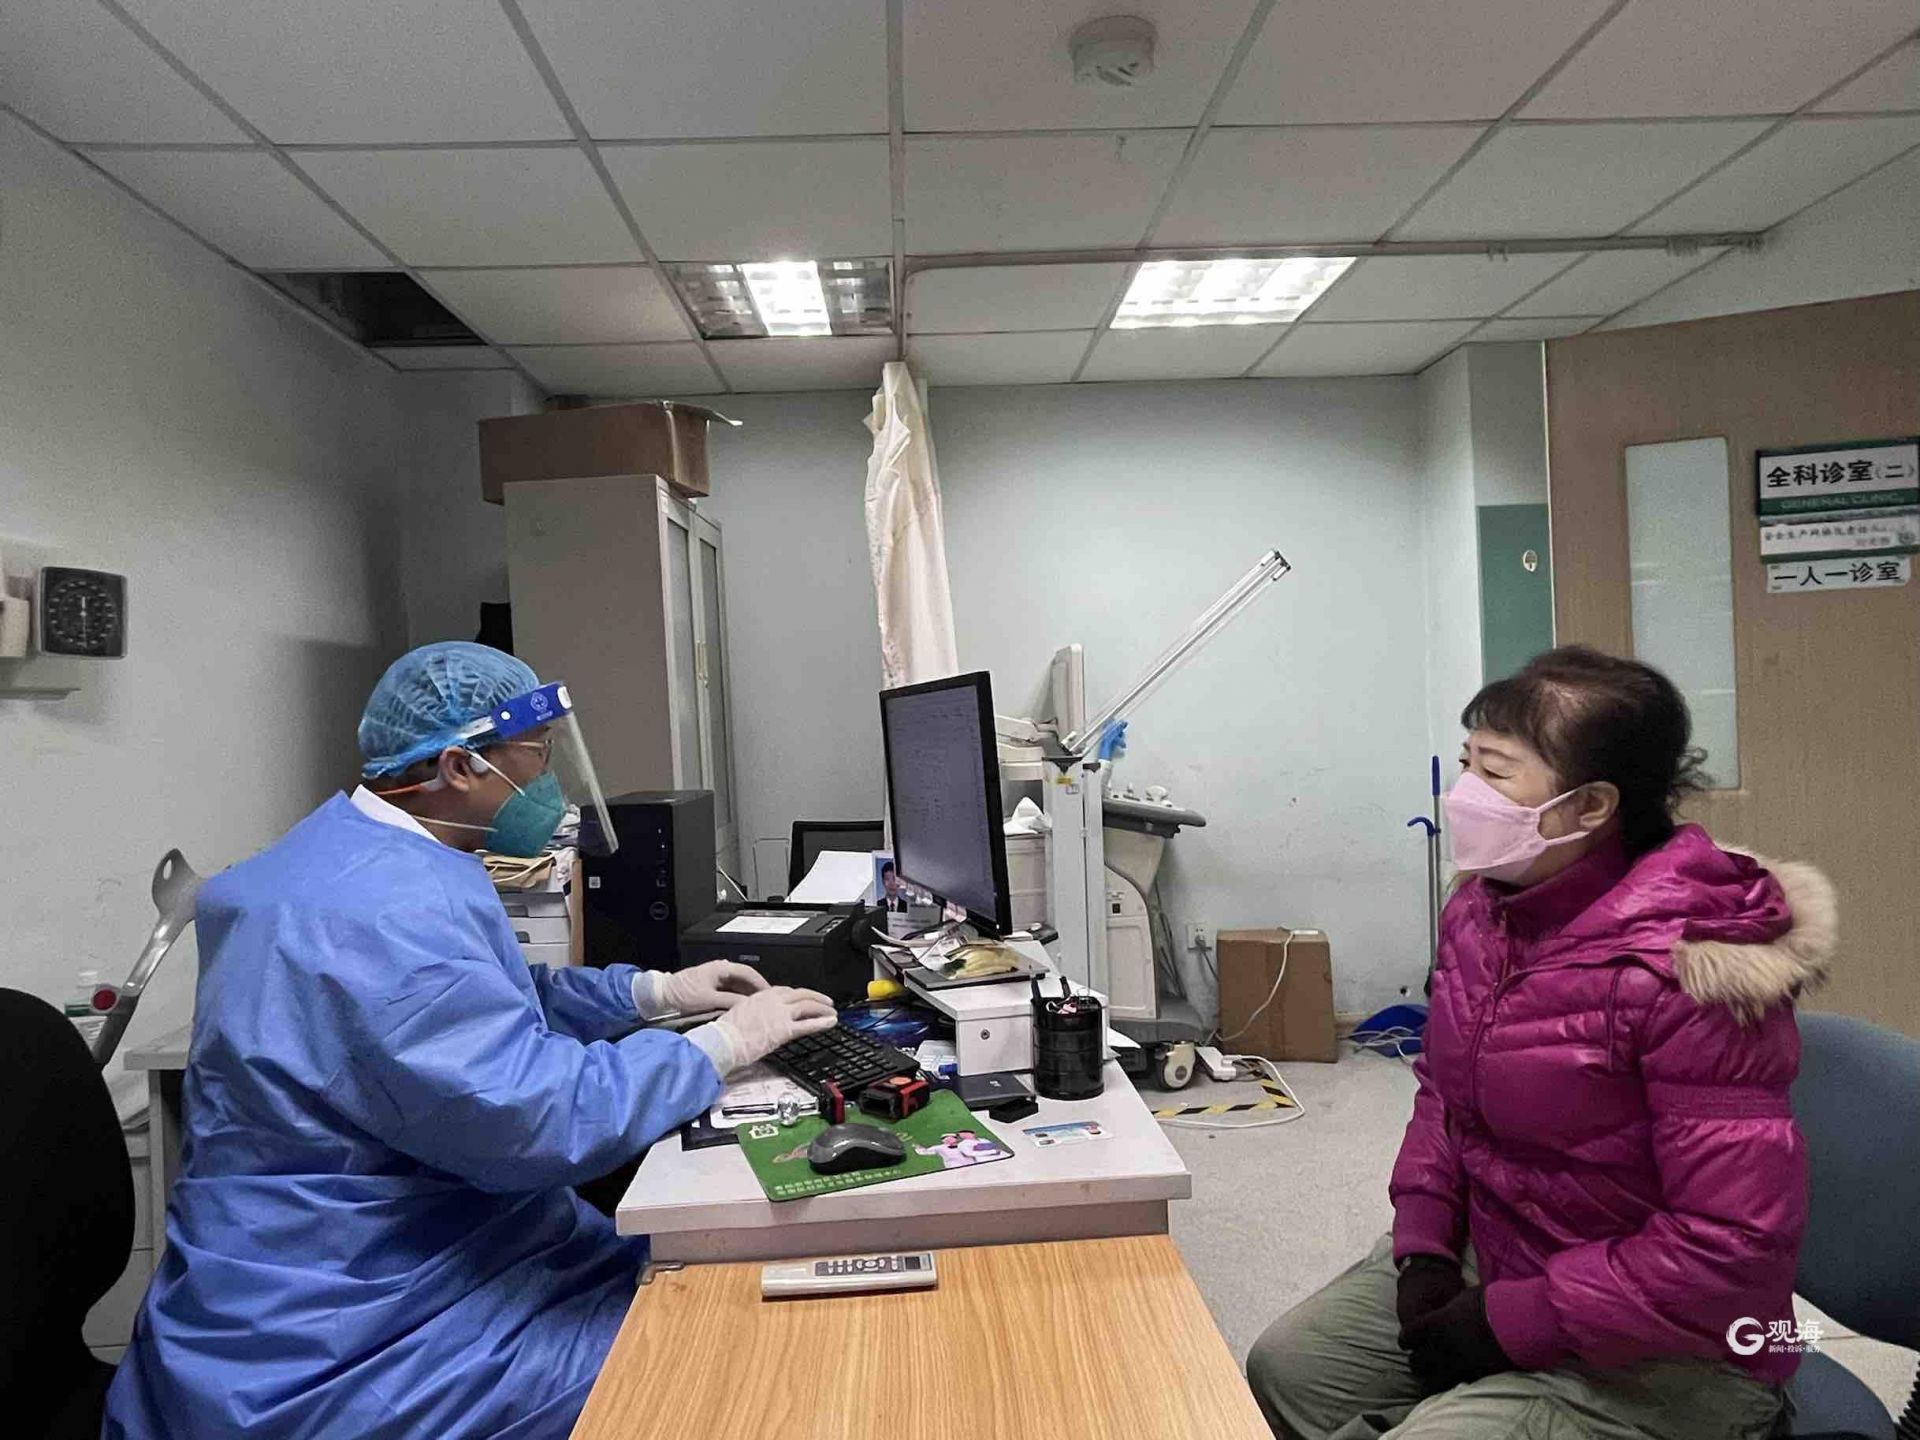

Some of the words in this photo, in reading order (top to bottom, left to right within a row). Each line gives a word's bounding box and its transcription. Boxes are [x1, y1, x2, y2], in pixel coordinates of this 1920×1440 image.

[1774, 561, 1900, 586] 一人一诊室
